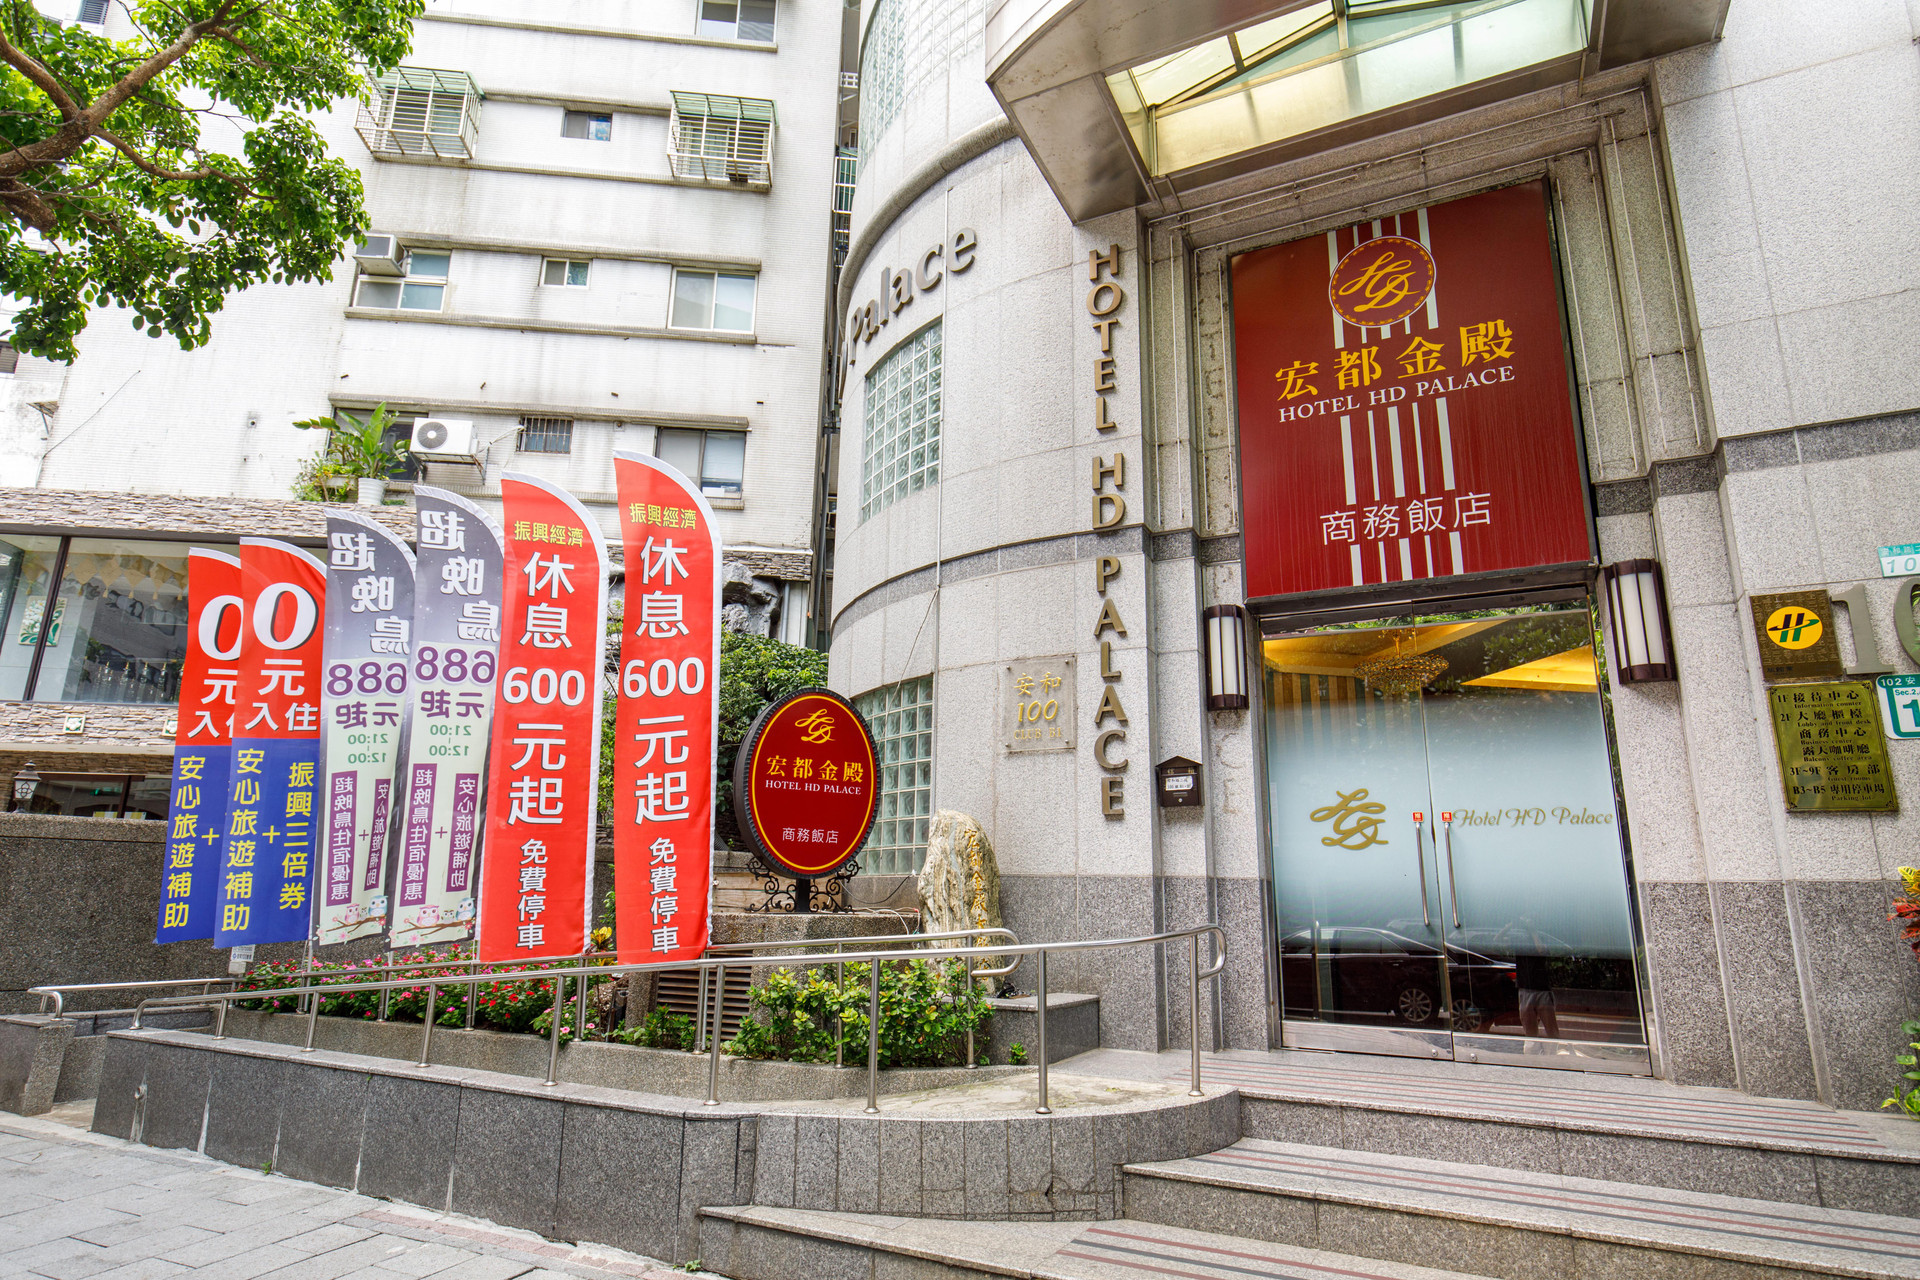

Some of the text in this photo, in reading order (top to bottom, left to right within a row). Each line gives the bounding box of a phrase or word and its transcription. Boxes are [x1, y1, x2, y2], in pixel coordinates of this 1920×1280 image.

[849, 227, 978, 365] Palace
[1275, 318, 1516, 401] 宏都金殿
[1278, 365, 1516, 423] HOTEL HD PALACE
[514, 520, 584, 548] 振興經濟
[629, 502, 697, 531] 振興經濟
[1086, 243, 1128, 817] HOTEL HD PALACE
[1319, 491, 1493, 546] 商務飯店
[502, 666, 586, 707] 600
[622, 656, 705, 699] 600
[1013, 671, 1062, 696] 安和
[244, 702, 319, 732] 入住
[1017, 699, 1059, 722] 100
[1014, 728, 1042, 740] CLUB
[765, 779, 862, 796] HOTEL HD PALACE
[766, 754, 864, 783] 宏都金殿
[279, 761, 315, 910] 振興三倍券
[782, 827, 839, 844] 商務飯店
[1453, 806, 1613, 828] Hotel HD Palace
[163, 755, 206, 929] 安心旅遊補助
[221, 748, 265, 932] 安心旅遊補助
[516, 838, 548, 950] 免費停車
[649, 836, 680, 954] 免費停車
